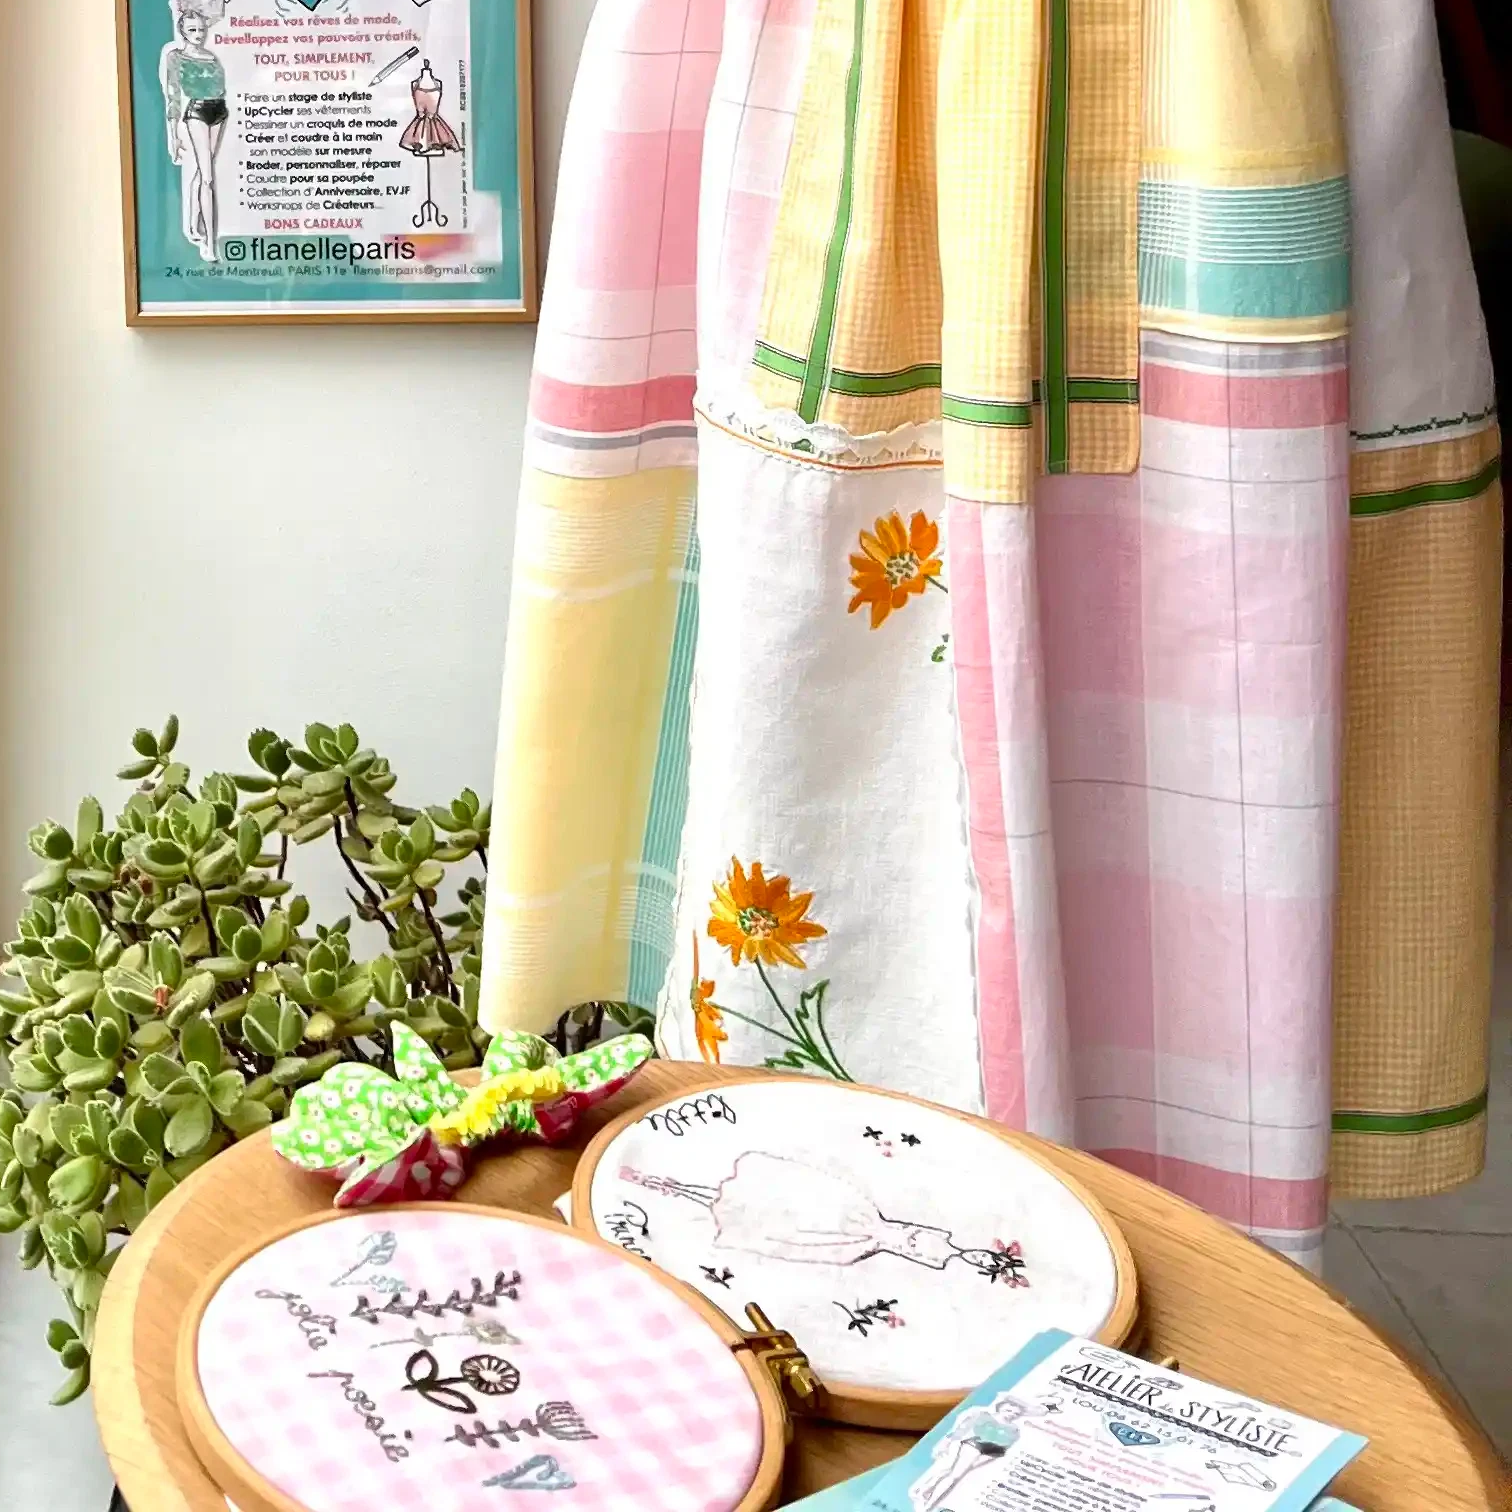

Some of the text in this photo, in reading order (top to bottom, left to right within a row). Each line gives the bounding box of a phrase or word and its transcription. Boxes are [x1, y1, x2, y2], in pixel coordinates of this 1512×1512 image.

[230, 16, 279, 27] Réalisez
[307, 15, 340, 26] rêves
[343, 13, 359, 25] de
[363, 12, 402, 25] mode,
[292, 35, 314, 44] vos
[274, 71, 309, 82] POUR
[314, 70, 347, 80] TOUS
[244, 91, 373, 103] Faire un stage de styliste
[296, 107, 313, 115] ses
[306, 119, 345, 130] croquis
[347, 119, 362, 128] de
[365, 118, 398, 127] mode
[245, 131, 383, 143] Créer et coudre à la main
[249, 148, 268, 156] son
[315, 147, 330, 156] sur
[332, 147, 373, 155] mesure
[246, 160, 284, 170] Broder,
[361, 159, 402, 170] réparer
[289, 175, 314, 184] pour
[316, 174, 330, 182] sa
[332, 172, 375, 184] poupée
[386, 186, 411, 195] EVJF
[305, 200, 320, 210] de
[264, 218, 363, 229] BONS CADEAUX
[251, 237, 415, 265] flanelleparis
[288, 264, 321, 276] PARIS
[1180, 1401, 1296, 1452] STYLISTE
